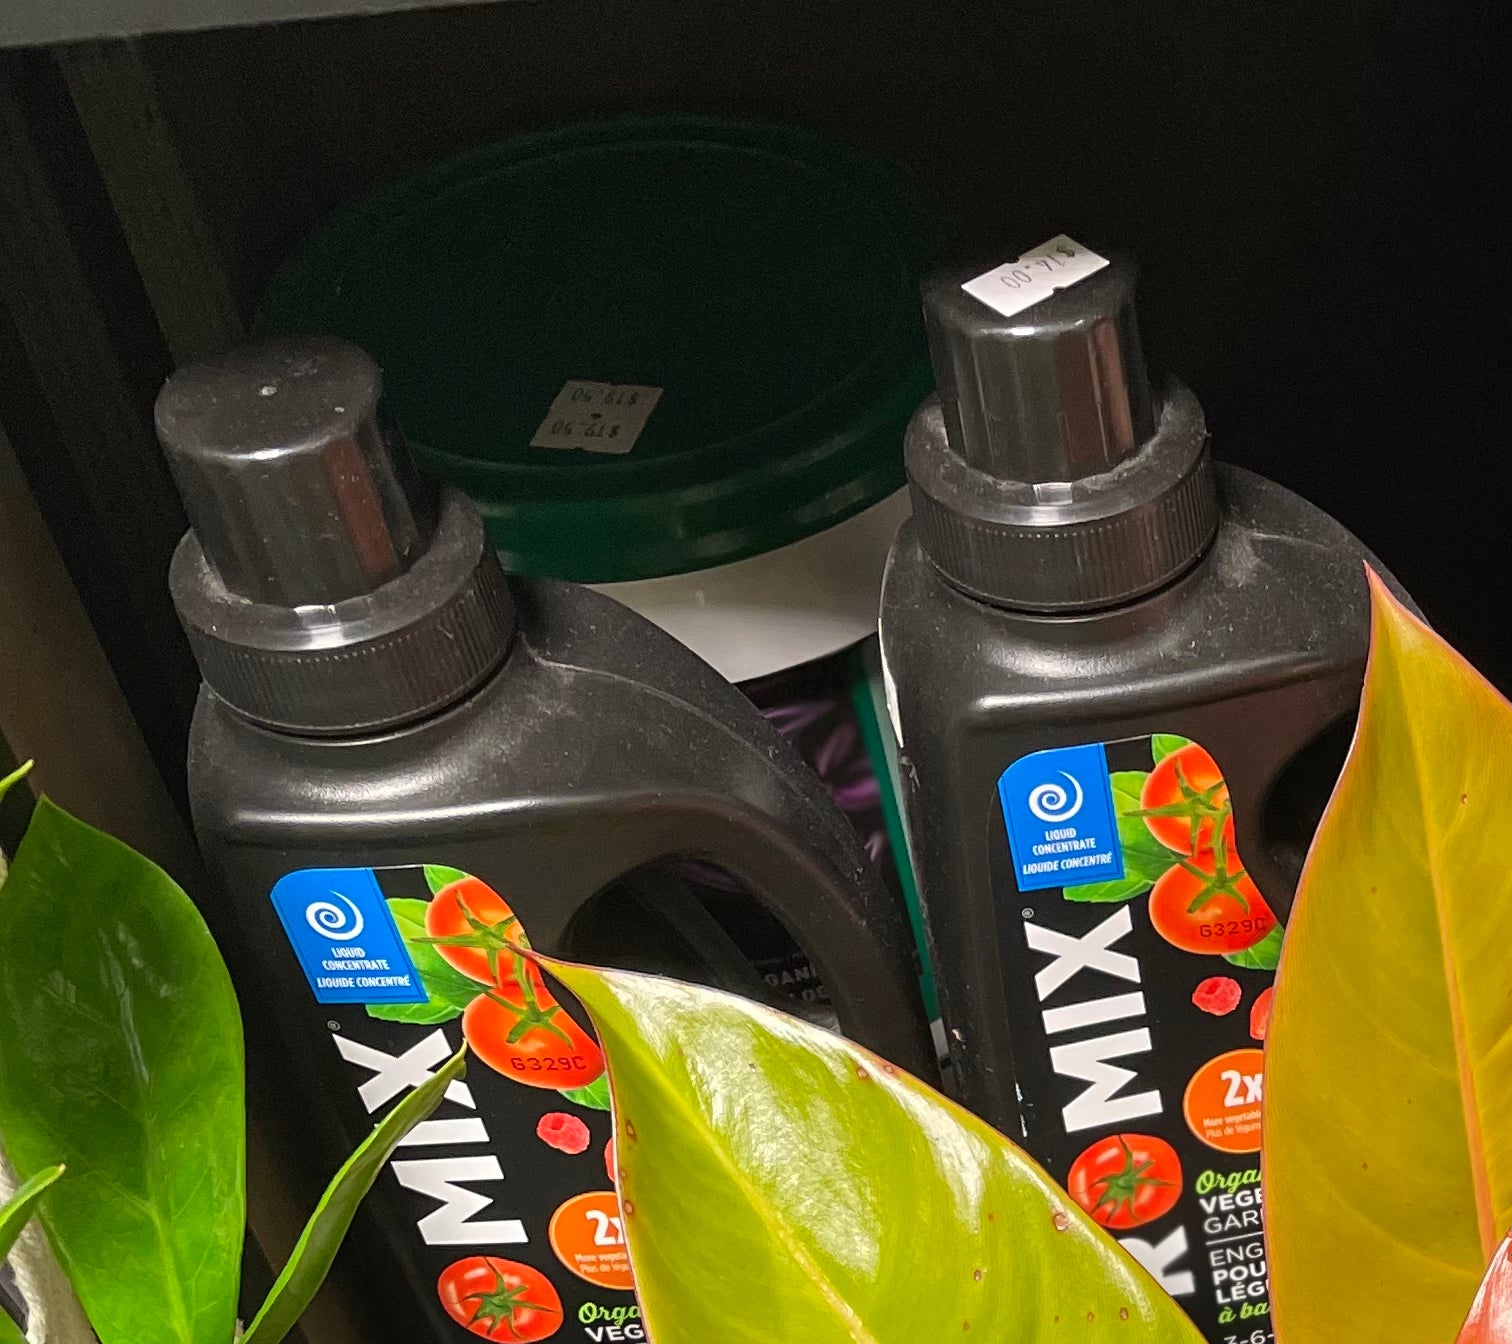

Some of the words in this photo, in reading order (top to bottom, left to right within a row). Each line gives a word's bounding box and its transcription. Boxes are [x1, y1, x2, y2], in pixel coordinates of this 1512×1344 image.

[1044, 827, 1077, 842] LIQUID
[1032, 837, 1097, 857] CONCENTRATE
[1022, 860, 1060, 875] LIQUIDE
[1060, 851, 1113, 870] CONCENTRÉ
[330, 946, 367, 959] LIQUID
[321, 959, 391, 971] CONCENTRATE
[316, 976, 355, 988] LIQUIDE
[355, 974, 412, 988] CONCENTRÉ
[1023, 904, 1163, 1134] MIX
[332, 1028, 529, 1244] MIX
[1203, 1209, 1265, 1235] GAR
[1208, 1241, 1264, 1268] ENG
[1212, 1260, 1267, 1286] POU
[1215, 1278, 1269, 1305] LÉG
[1217, 1305, 1237, 1325] à
[584, 1323, 645, 1343] VEG
